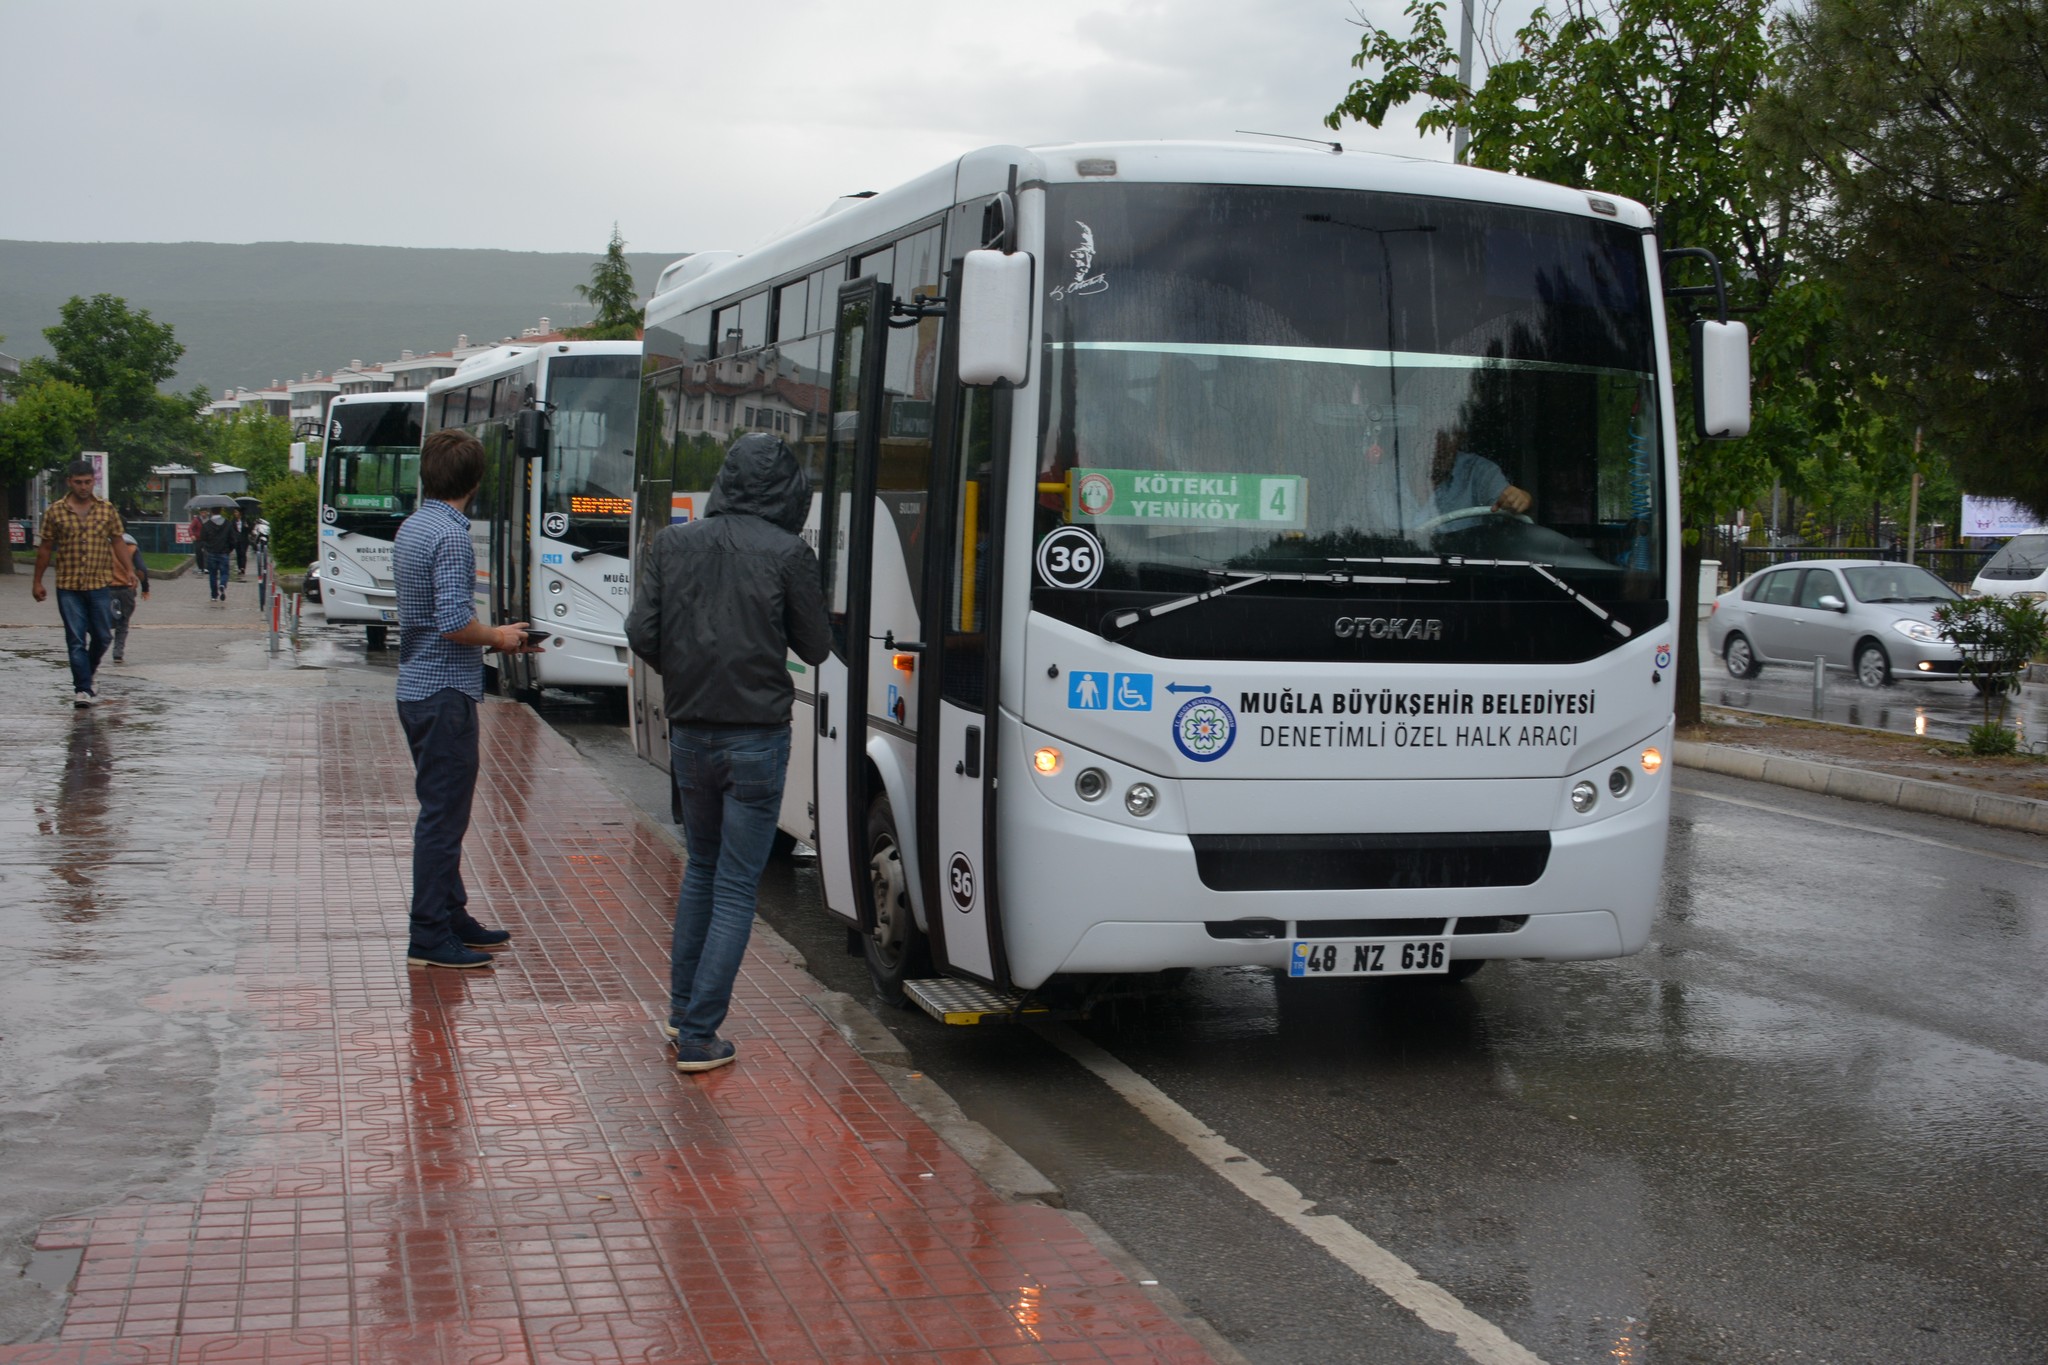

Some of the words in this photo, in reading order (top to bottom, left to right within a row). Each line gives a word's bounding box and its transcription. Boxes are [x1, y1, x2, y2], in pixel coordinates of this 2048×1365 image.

[1133, 473, 1237, 496] KÖTEKLİ
[1131, 500, 1240, 519] YENİKÖY
[1269, 486, 1286, 515] 4
[325, 511, 334, 519] 41
[547, 519, 564, 530] 45
[1050, 546, 1091, 572] 36
[603, 572, 631, 583] MUĞL
[1334, 616, 1444, 640] OTOKAR
[1240, 687, 1324, 714] MUĞLA
[1332, 688, 1474, 717] BÜYÜKŞEHİR
[1482, 689, 1596, 714] BELEDİYESİ
[1260, 721, 1386, 747] DENETİMLİ
[1394, 722, 1448, 747] ÖZEL
[1456, 726, 1511, 746] HALK
[1518, 726, 1578, 746] ARACI
[952, 867, 972, 897] 36
[1293, 961, 1304, 969] TR
[1307, 945, 1338, 972] 48
[1353, 945, 1386, 972] NZ
[1401, 942, 1444, 969] 636
